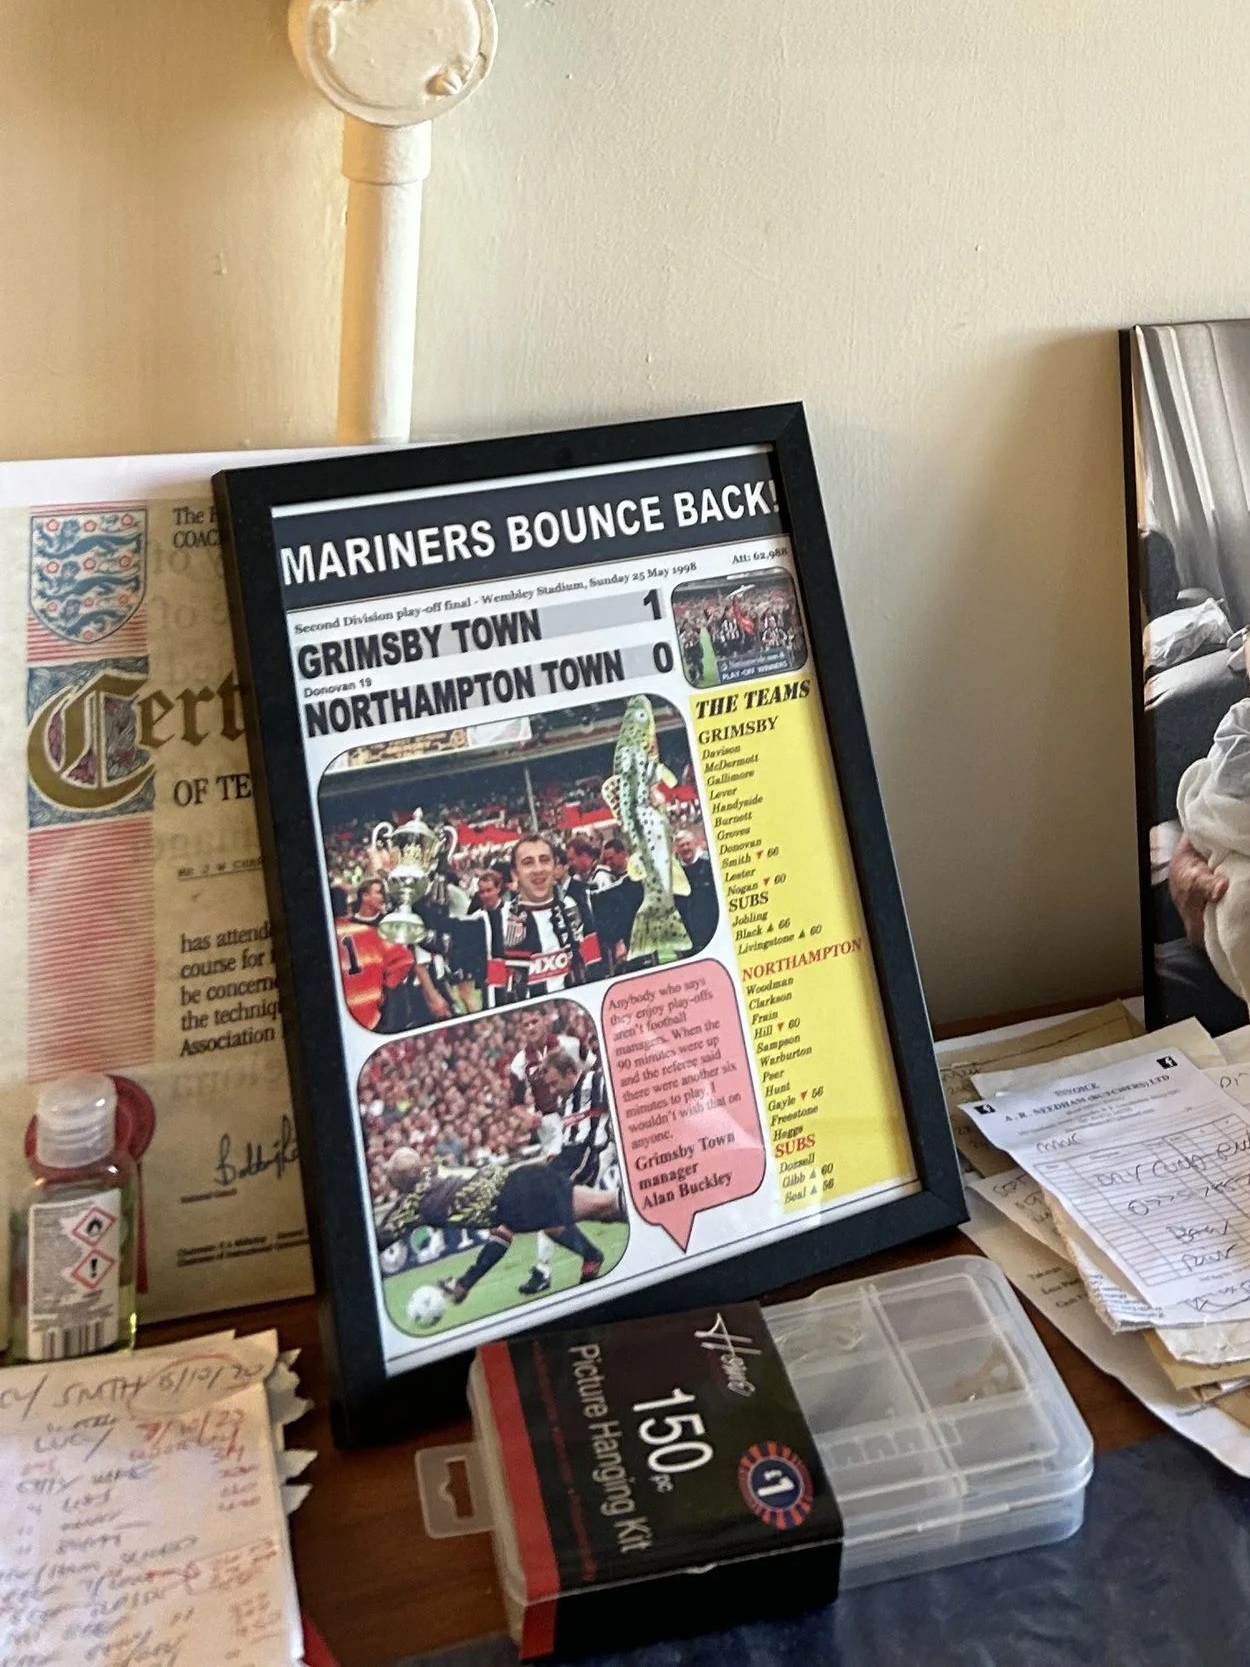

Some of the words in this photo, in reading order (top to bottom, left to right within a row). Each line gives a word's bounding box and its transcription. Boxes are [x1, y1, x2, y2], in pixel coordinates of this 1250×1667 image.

[279, 520, 497, 586] MARINERS
[506, 496, 665, 554] BOUNCE
[672, 478, 781, 528] BACK!
[294, 617, 340, 635] Second
[343, 610, 394, 627] Division
[397, 599, 442, 622] play-off
[444, 597, 472, 611] final
[482, 586, 535, 605] Wembley
[588, 571, 631, 589] Sunday
[632, 570, 646, 582] 25
[647, 567, 670, 581] May
[672, 562, 697, 575] 1998
[298, 623, 443, 680] GRIMSBY
[451, 608, 542, 653] TOWN
[643, 589, 663, 621] 1
[303, 680, 356, 699] Donovan
[359, 677, 372, 688] 19
[305, 664, 537, 739] NORTHAMPTON
[541, 649, 625, 694] TOWN
[652, 641, 673, 674] 0
[696, 693, 739, 720] THE
[744, 679, 811, 710] TEAMS
[699, 715, 779, 745] GRIMSBY
[173, 777, 209, 807] OF
[728, 891, 769, 912] SUBS
[180, 933, 211, 954] has
[181, 957, 236, 979] course
[242, 949, 265, 969] for
[742, 938, 862, 982] NORTHAMPTON
[181, 985, 201, 1006] be
[608, 988, 656, 1011] Anybody
[659, 983, 681, 996] who
[181, 1011, 208, 1031] the
[672, 1023, 703, 1040] When
[704, 1020, 720, 1031] the
[180, 1027, 275, 1057] Association
[620, 1074, 640, 1088] and
[700, 1049, 721, 1063] said
[635, 1144, 695, 1171] Grimsby
[698, 1132, 735, 1151] Town
[775, 1134, 816, 1159] SUBS
[639, 1162, 699, 1190] manager
[642, 1191, 675, 1210] Alan
[679, 1171, 732, 1197] Buckley
[633, 1388, 714, 1473] 150
[568, 1343, 608, 1419] Picture
[588, 1420, 637, 1516] Hanging
[613, 1517, 654, 1554] Kit
[757, 1469, 795, 1496] £1
